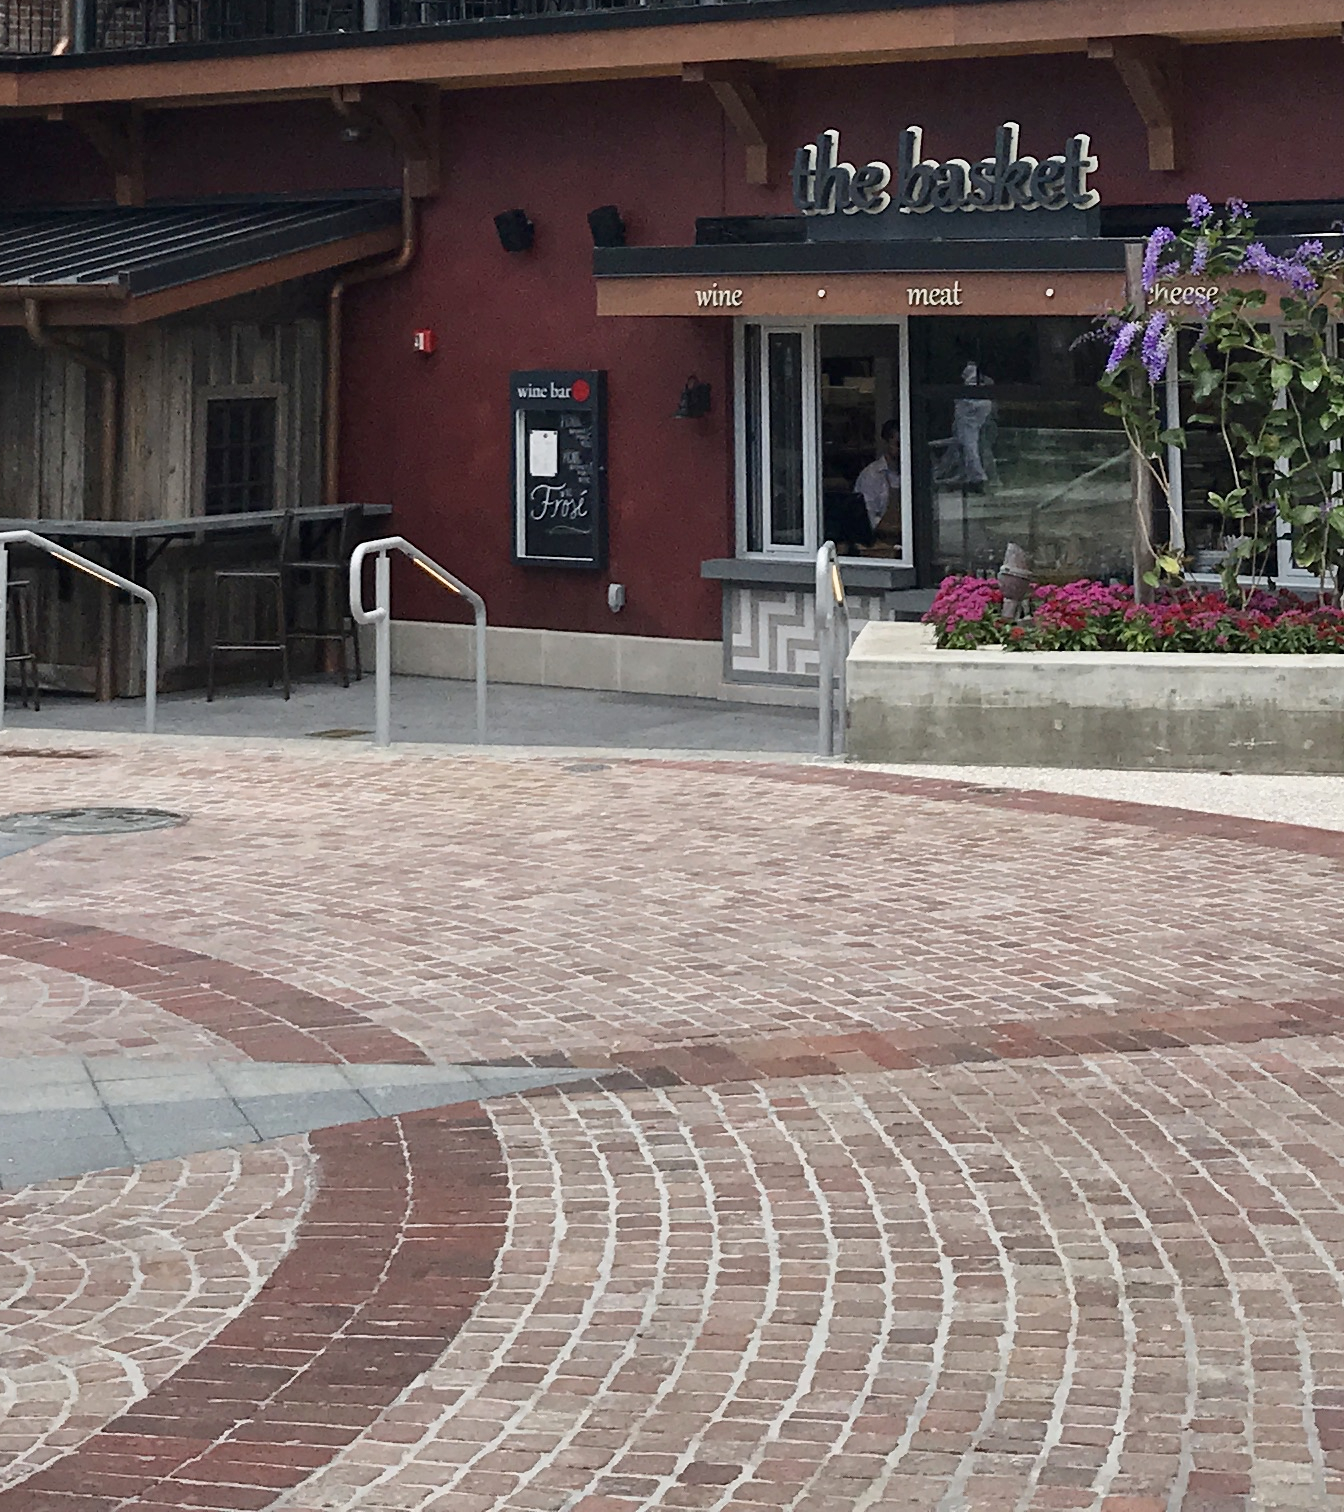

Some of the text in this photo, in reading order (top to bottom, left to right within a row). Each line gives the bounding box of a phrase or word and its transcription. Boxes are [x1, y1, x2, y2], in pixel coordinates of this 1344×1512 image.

[791, 121, 1100, 215] the basket
[695, 282, 743, 307] wine
[906, 281, 963, 307] meat
[517, 382, 572, 399] wine bar
